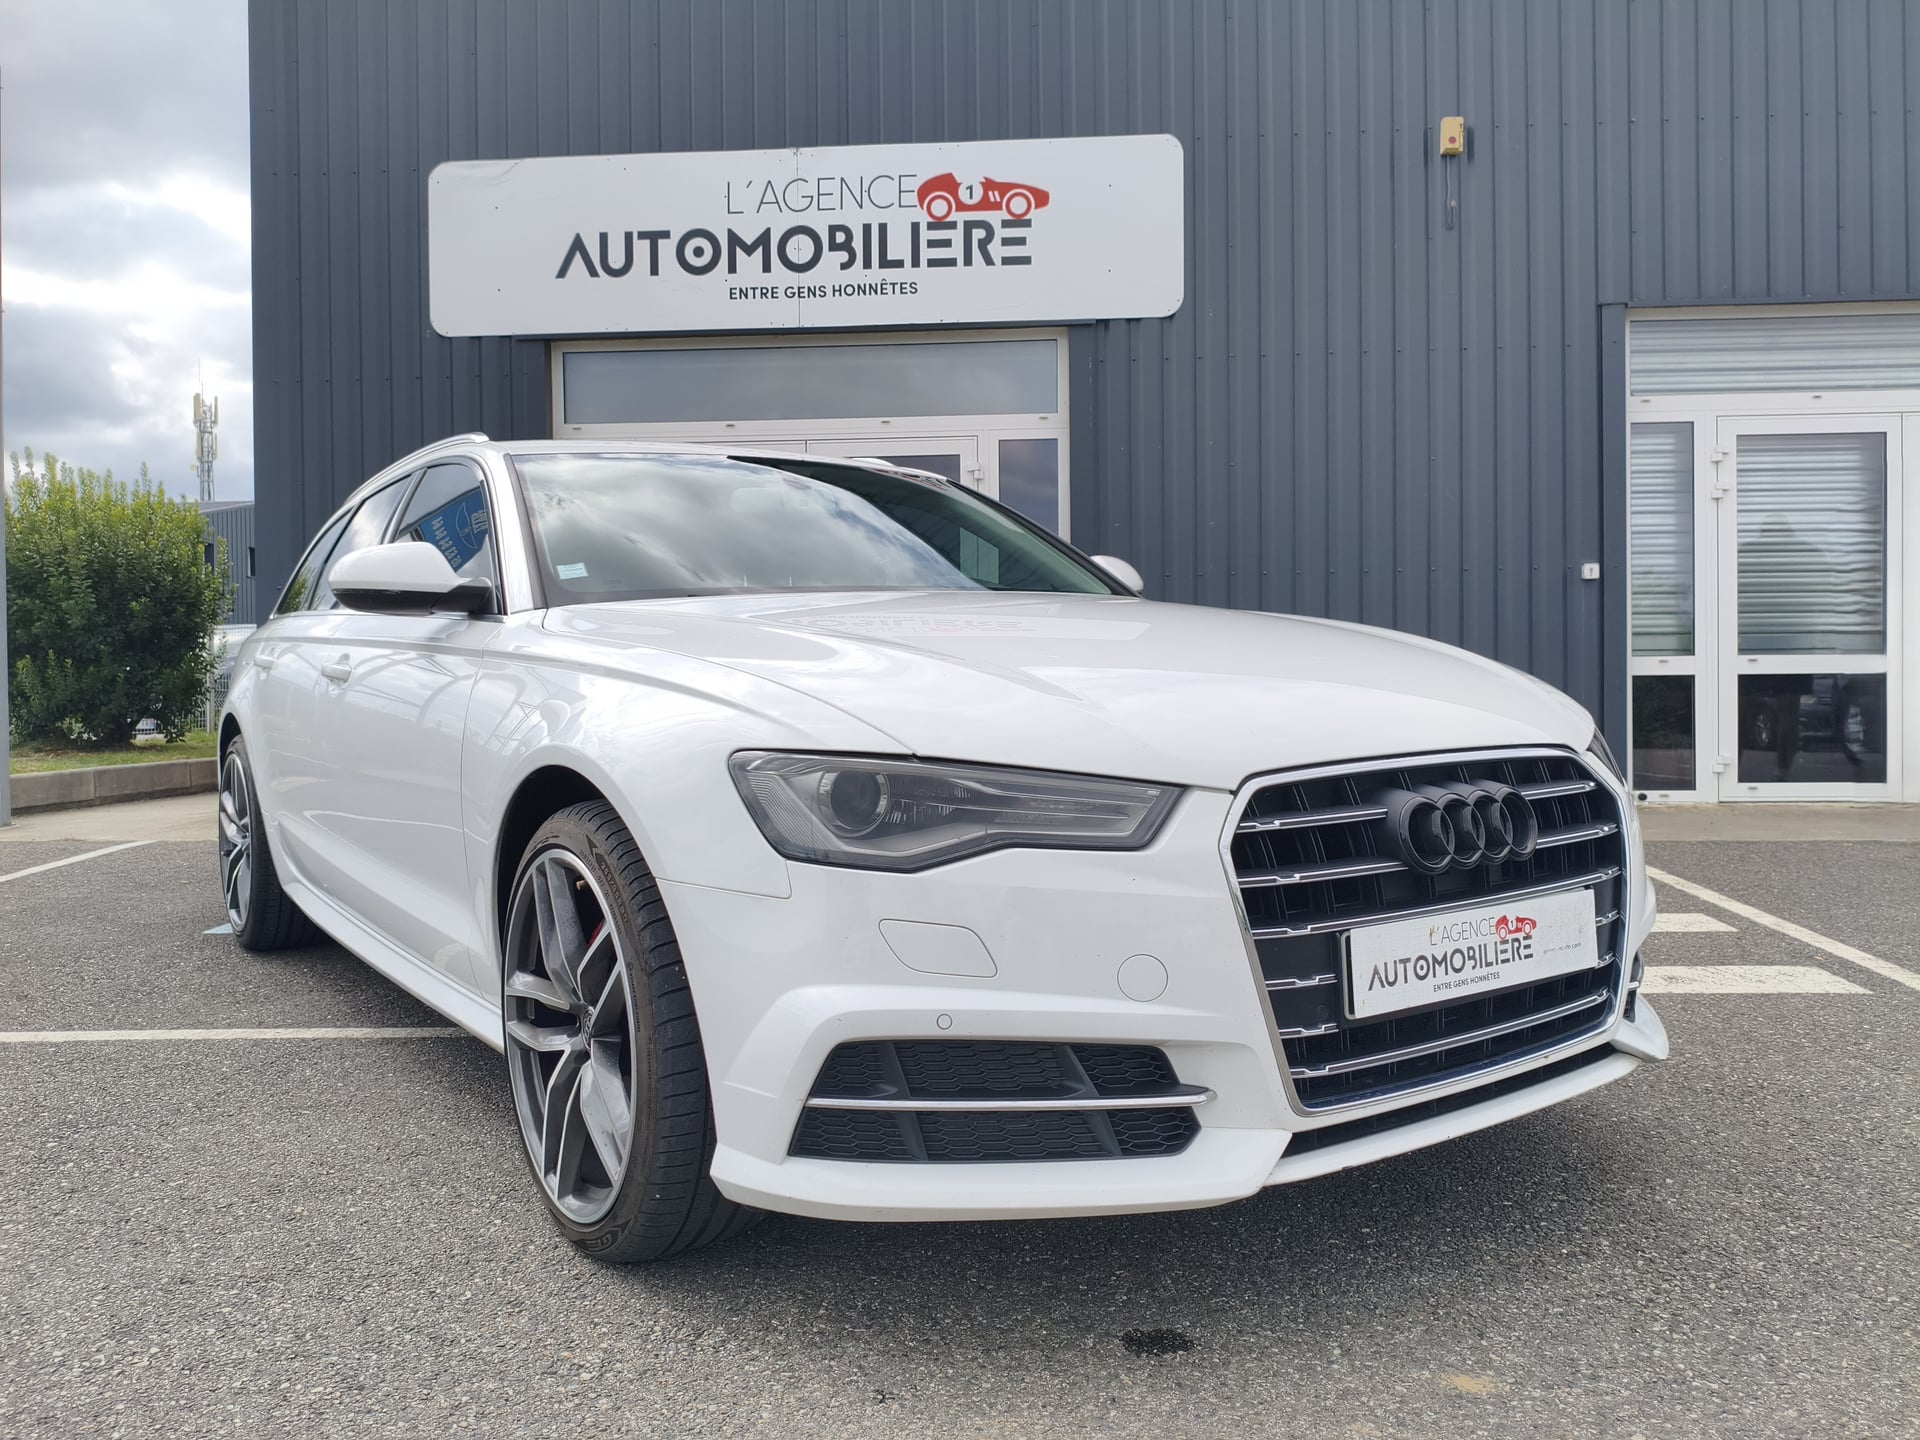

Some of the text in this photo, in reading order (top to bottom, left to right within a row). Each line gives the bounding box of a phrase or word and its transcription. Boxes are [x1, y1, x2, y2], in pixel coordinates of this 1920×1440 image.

[727, 174, 918, 214] L'AGENCE
[555, 218, 1032, 279] AUTOMOBILIERE
[729, 278, 918, 300] ENTRE GENS HONNÊTES
[1429, 916, 1496, 946] L'AGENCE
[1368, 935, 1534, 991] AUTOMOBILIERE
[1433, 971, 1501, 992] ENTRE GENS HONNÊTES
